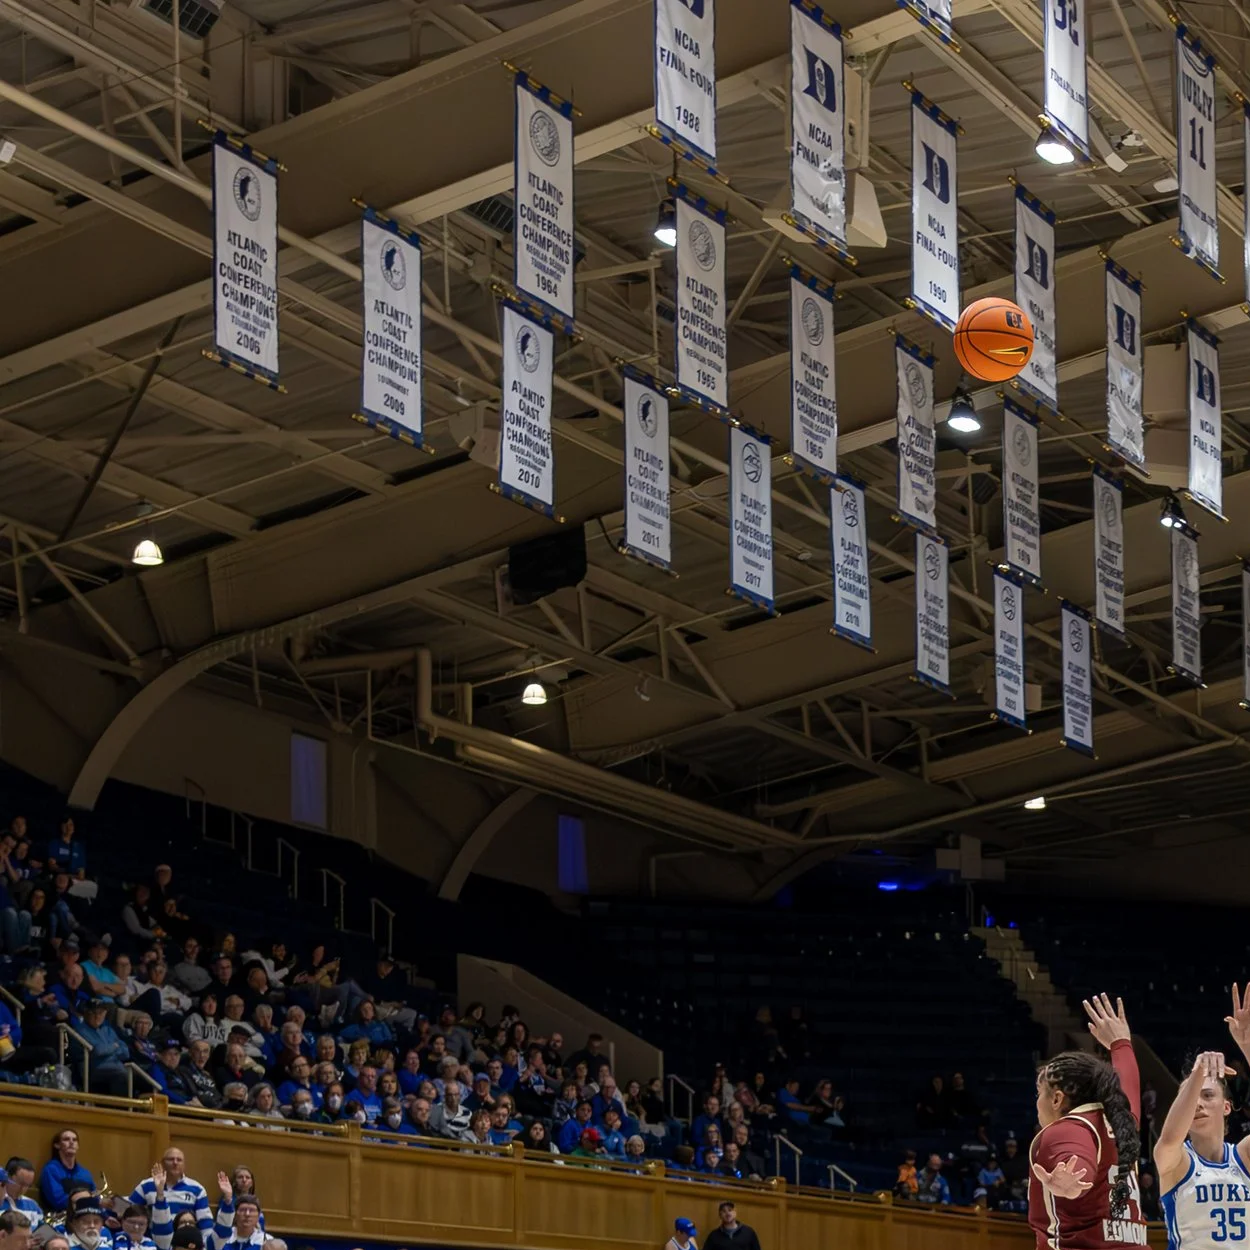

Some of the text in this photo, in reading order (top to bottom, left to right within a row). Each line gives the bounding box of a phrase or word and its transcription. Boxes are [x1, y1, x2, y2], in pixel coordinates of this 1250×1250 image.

[674, 27, 701, 59] NCAA
[659, 46, 688, 79] FINAL
[675, 105, 700, 133] 1988
[808, 123, 832, 151] NCAA
[1189, 117, 1206, 170] 11
[527, 171, 563, 206] ATLANTIC
[532, 192, 559, 220] COAST
[520, 203, 572, 247] CONFERENCE
[227, 229, 268, 264] ATLANTIC
[522, 223, 570, 265] CHAMPIONS
[916, 230, 937, 257] FINAL
[232, 251, 263, 278] COAST
[219, 261, 277, 304] CONFERENCE
[535, 273, 559, 298] 1964
[686, 276, 719, 307] ATLANTIC
[221, 282, 275, 321] CHAMPIONS
[374, 299, 413, 329] ATLANTIC
[692, 296, 714, 320] COAST
[382, 319, 408, 344] COAST
[680, 305, 727, 344] CONFERENCE
[236, 331, 261, 355] 2006
[366, 330, 419, 369] CONFERENCE
[368, 349, 418, 385] CHAMPIONS
[383, 393, 406, 416] 2009
[511, 379, 545, 409] ATLANTIC
[518, 398, 541, 422] COAST
[518, 467, 541, 489] 2010
[1210, 1207, 1246, 1242] 35
